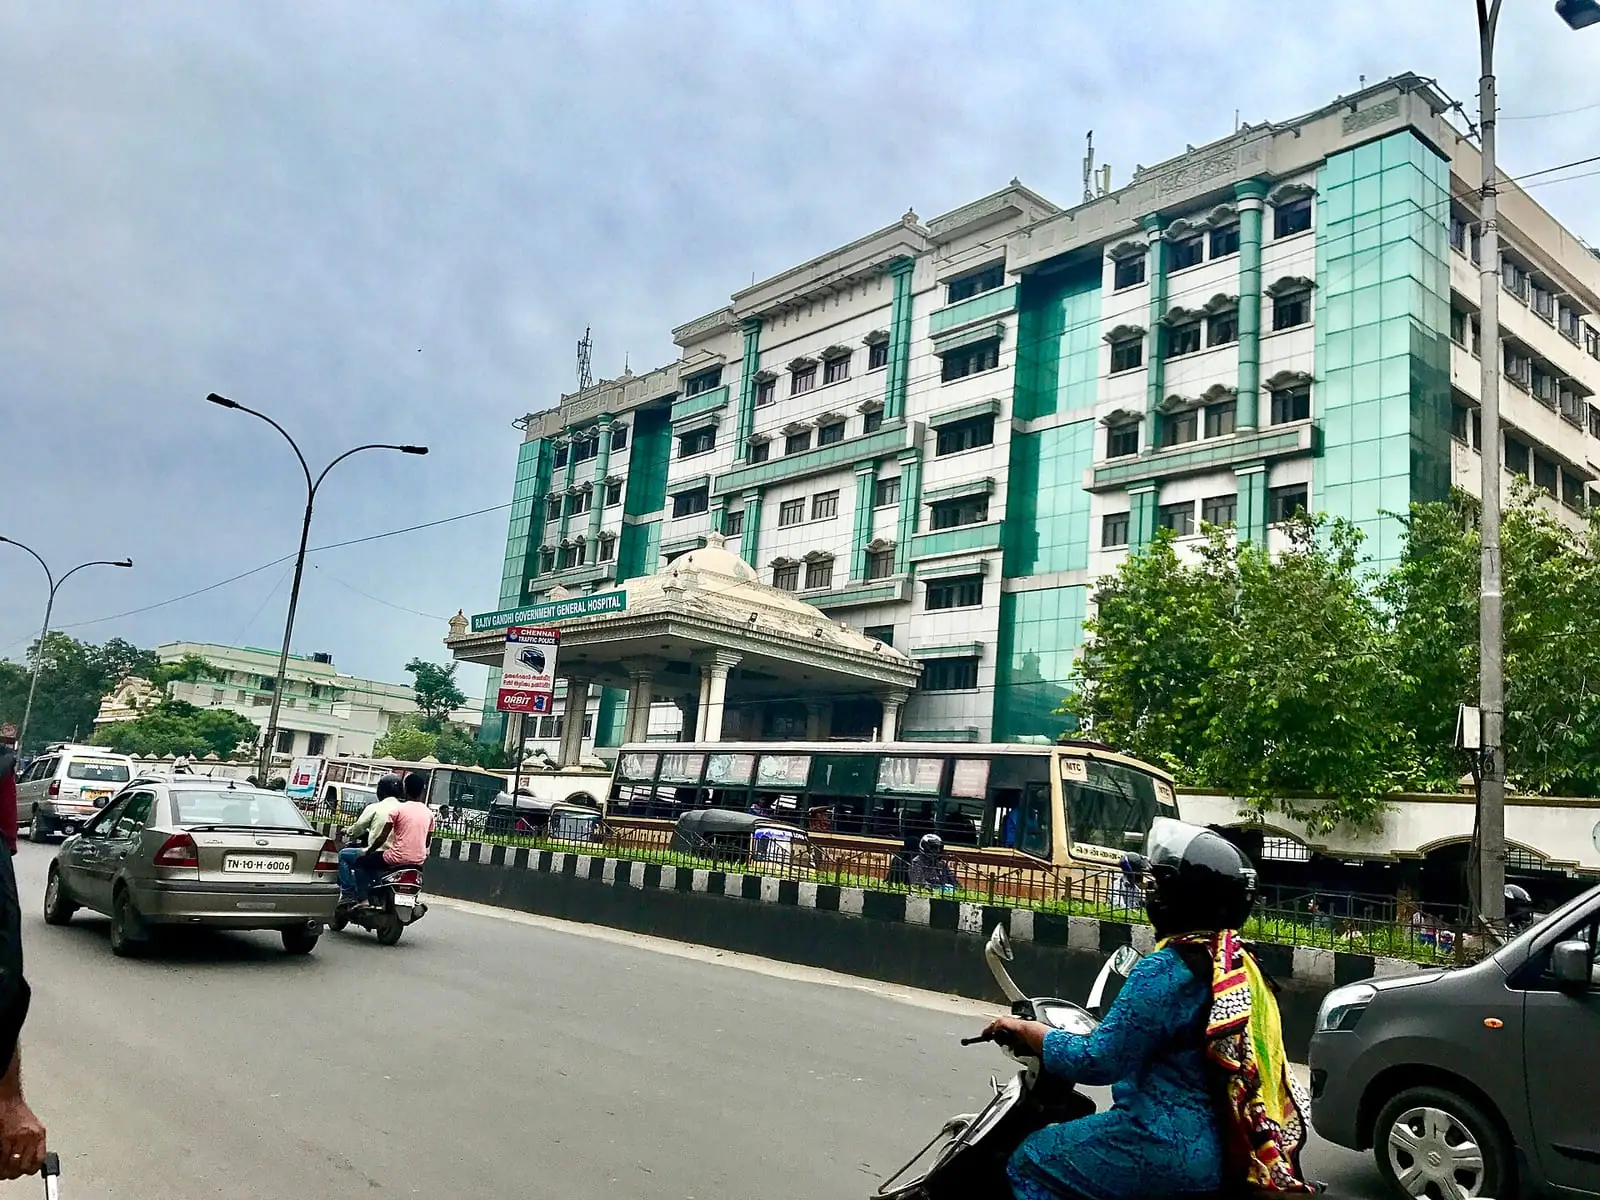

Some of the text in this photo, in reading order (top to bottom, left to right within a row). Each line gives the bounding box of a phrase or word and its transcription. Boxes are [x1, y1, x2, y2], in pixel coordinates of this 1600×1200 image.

[475, 595, 621, 629] RAJIV GANDHI GOVERNMENT GENERAL HOSPITAL
[520, 629, 556, 638] CHENNAI
[518, 635, 556, 645] TRAFFIC POLICE
[503, 695, 532, 705] ORBIT
[1065, 762, 1082, 772] MTC
